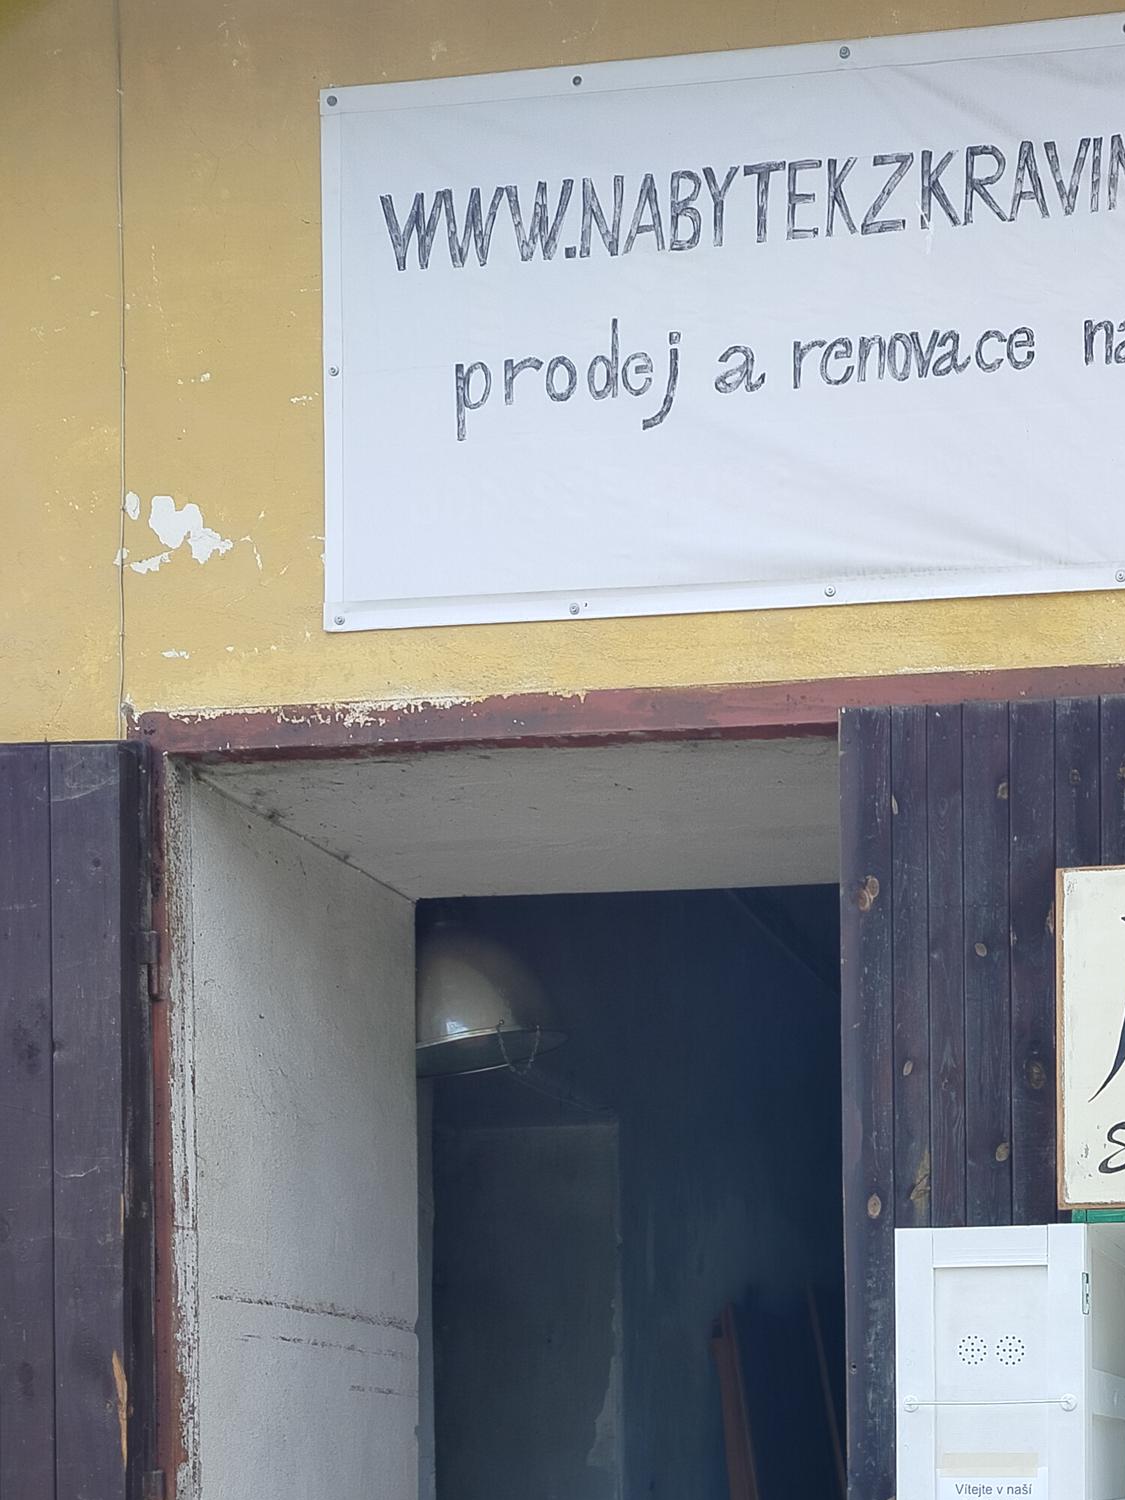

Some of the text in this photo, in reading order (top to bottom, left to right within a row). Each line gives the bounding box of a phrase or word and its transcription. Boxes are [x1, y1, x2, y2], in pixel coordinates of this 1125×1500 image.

[455, 317, 682, 442] prodej
[714, 345, 766, 394] a
[792, 326, 1036, 390] renovace
[996, 1486, 1004, 1495] v
[1006, 1483, 1033, 1496] naší
